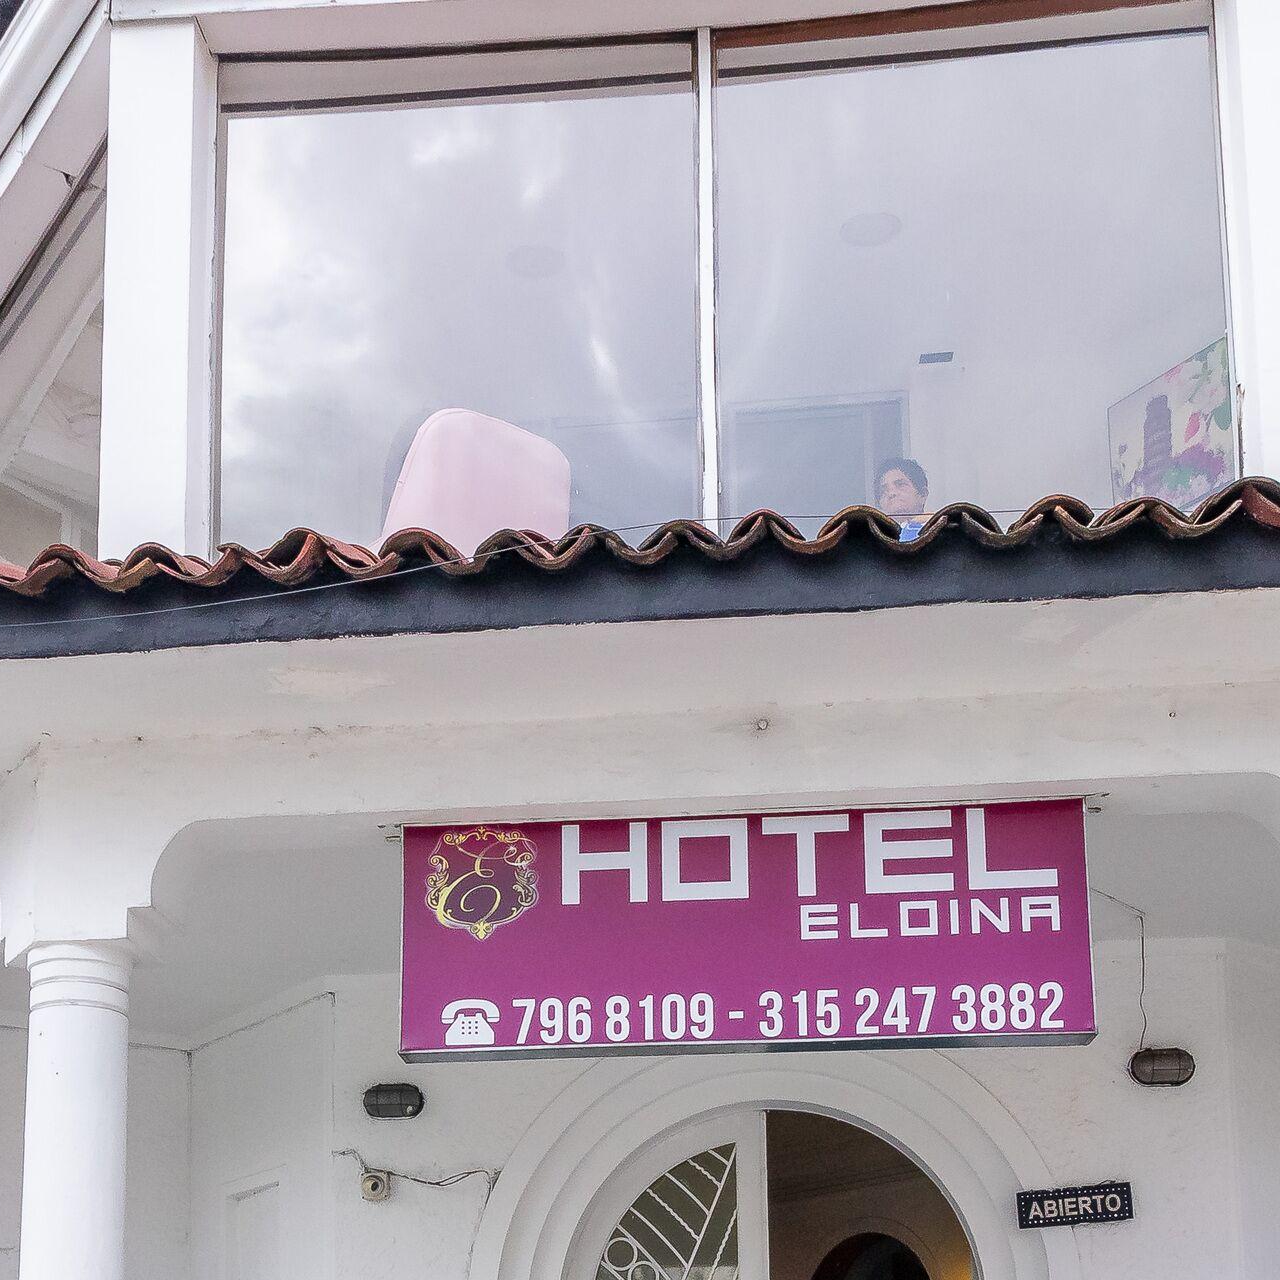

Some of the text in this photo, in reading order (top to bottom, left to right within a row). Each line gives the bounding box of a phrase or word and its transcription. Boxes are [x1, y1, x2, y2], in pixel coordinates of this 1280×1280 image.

[560, 807, 1059, 906] HOTEL
[800, 895, 1061, 941] ELOINA
[512, 997, 592, 1045] 796
[605, 992, 715, 1042] 8109
[758, 990, 841, 1037] 315
[855, 986, 937, 1035] 247
[951, 981, 1065, 1032] 3882
[1028, 1193, 1121, 1220] ABIERTO
